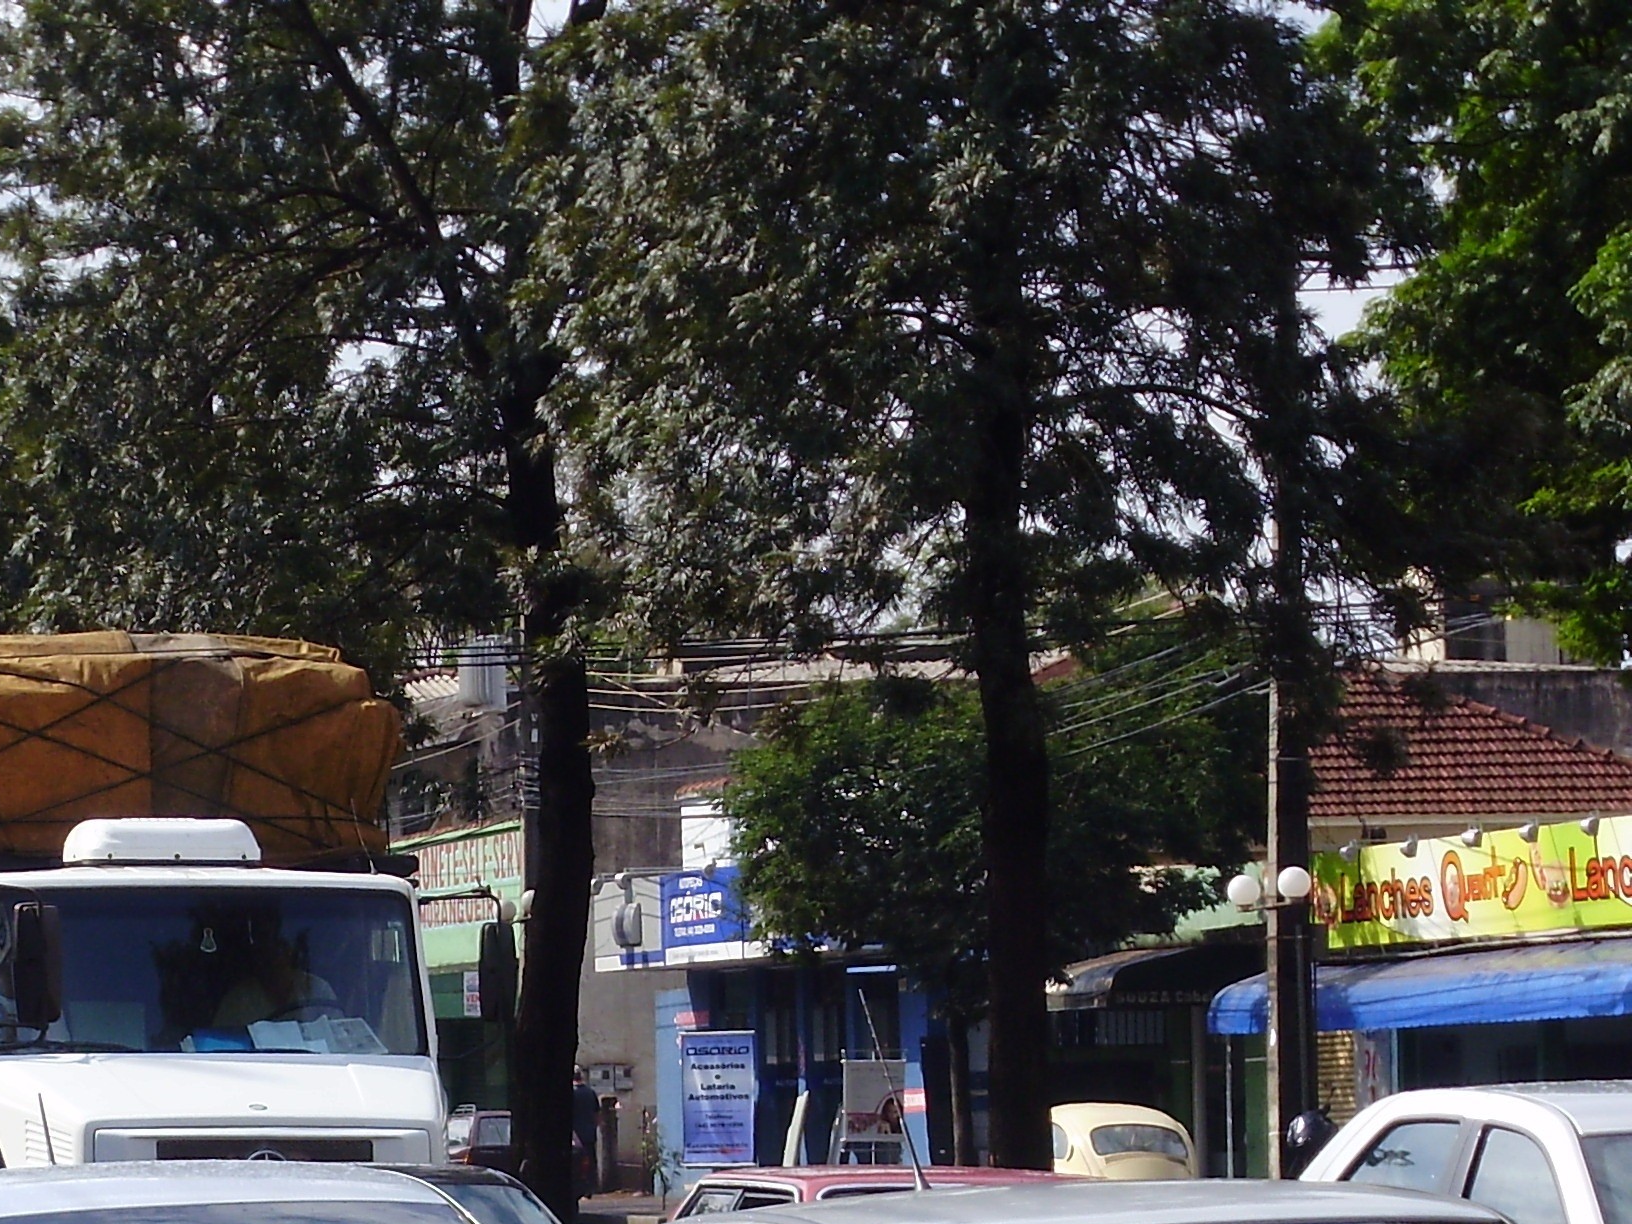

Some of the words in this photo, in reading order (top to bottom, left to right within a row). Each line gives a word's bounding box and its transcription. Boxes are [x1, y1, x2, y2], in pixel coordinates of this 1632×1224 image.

[1340, 867, 1434, 923] Lanches
[1568, 846, 1632, 900] Lanc
[420, 897, 497, 927] MORANGUEIR
[1114, 990, 1170, 1004] SOUZA
[700, 1083, 736, 1091] Lataria
